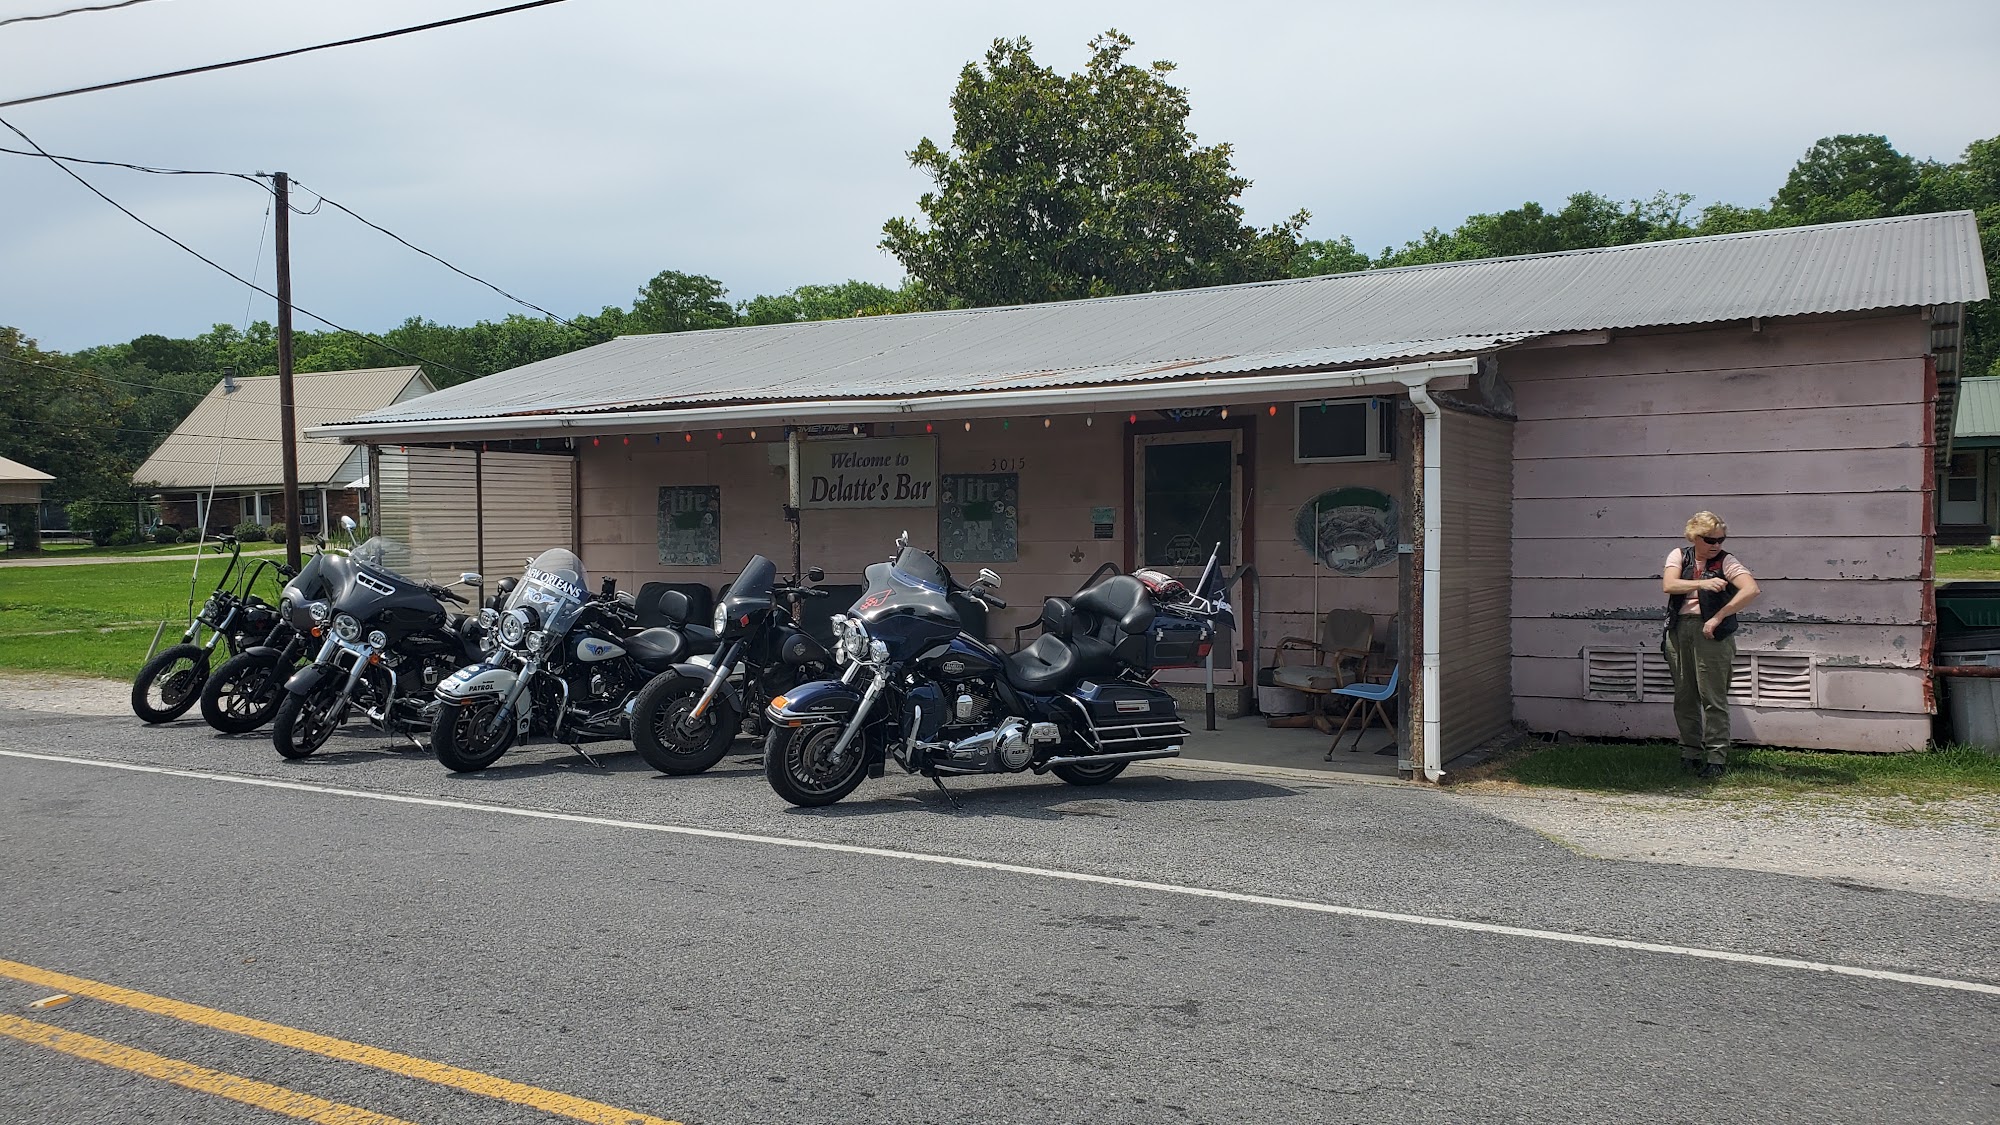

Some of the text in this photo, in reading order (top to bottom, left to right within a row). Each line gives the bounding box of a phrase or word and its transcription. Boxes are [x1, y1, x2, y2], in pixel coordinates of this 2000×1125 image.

[822, 424, 849, 432] TIME
[831, 452, 909, 468] Welcome to
[990, 458, 1025, 472] 3015
[809, 473, 931, 502] Delatte's Bar
[526, 568, 582, 598] NEW ORLEANS
[468, 684, 494, 692] PATROL
